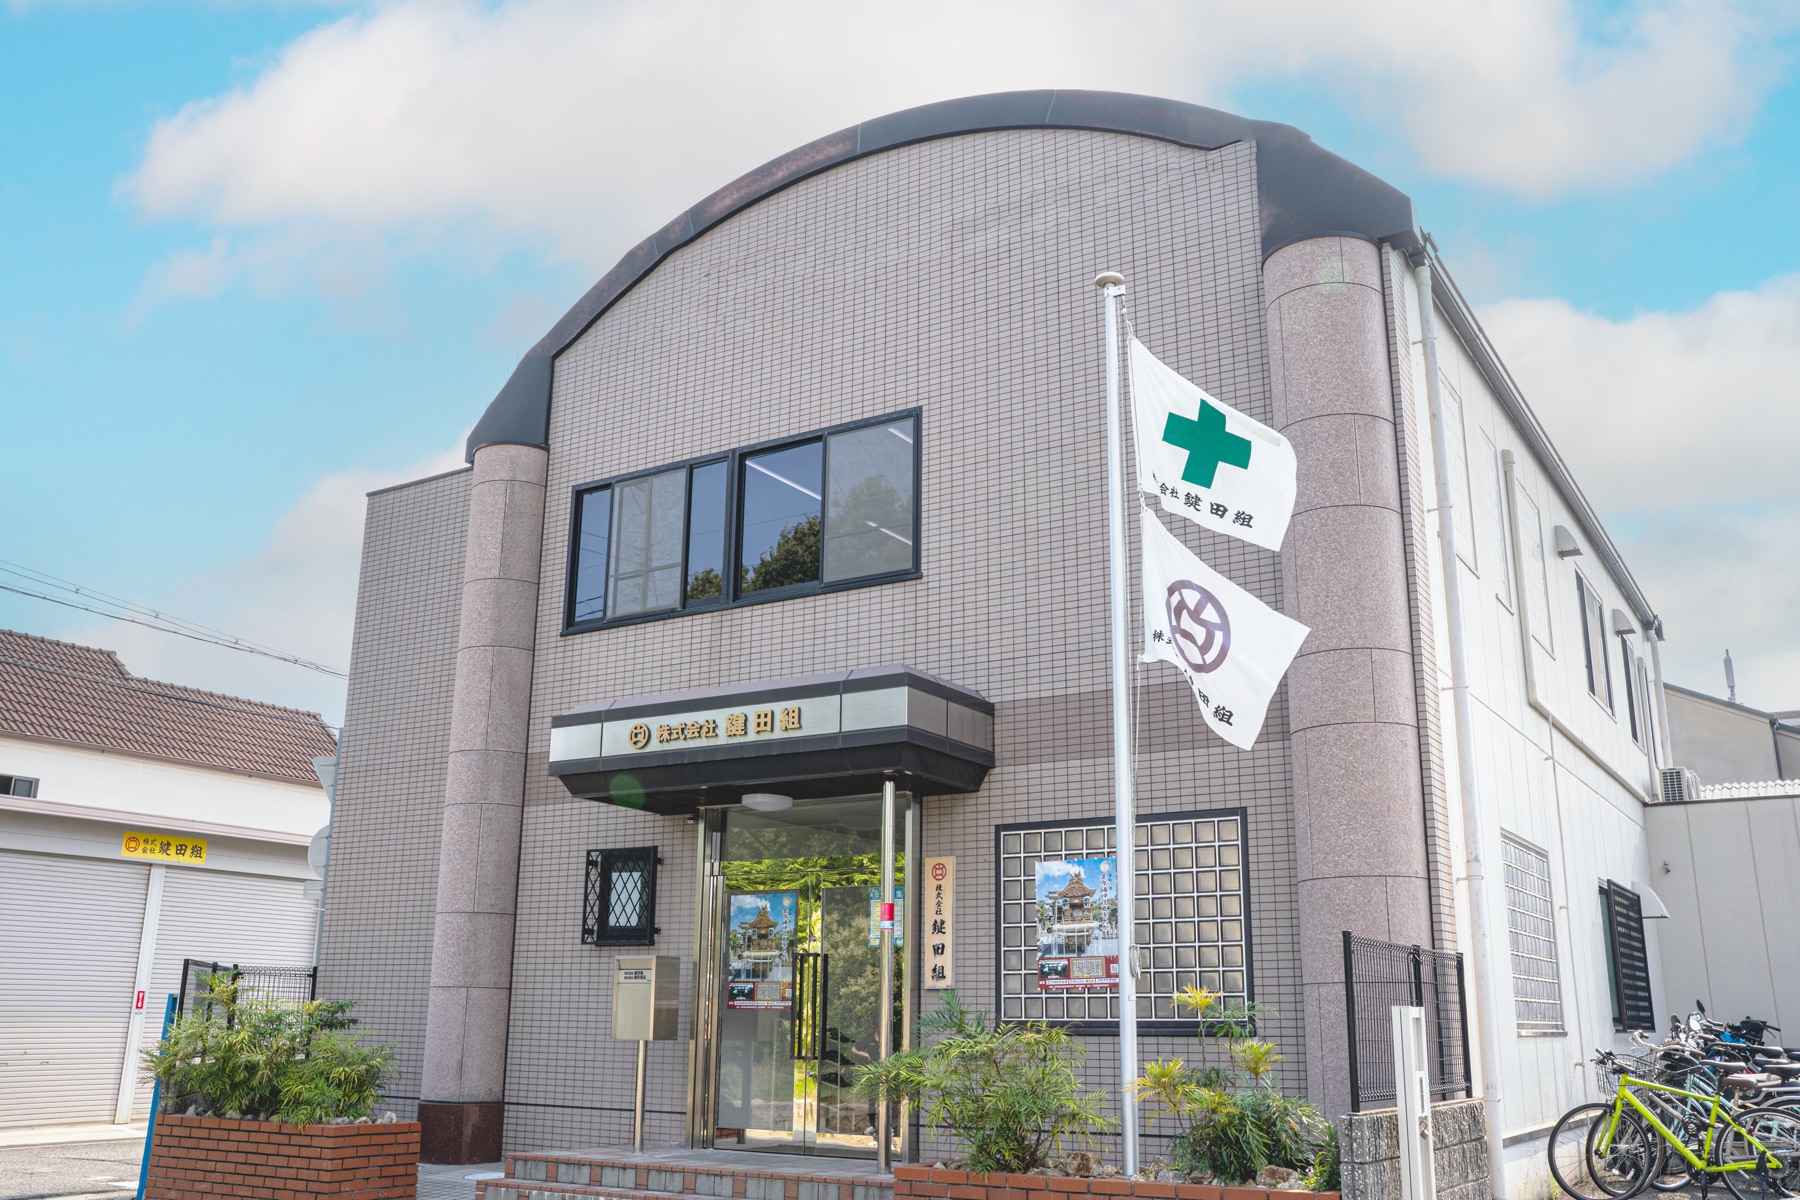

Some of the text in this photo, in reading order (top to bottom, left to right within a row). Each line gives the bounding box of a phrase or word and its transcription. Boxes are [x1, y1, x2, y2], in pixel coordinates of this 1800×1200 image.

[1184, 491, 1254, 529] 鍵田組
[656, 706, 802, 743] 株式会社 鍵田組
[158, 840, 203, 859] 鍵田組
[931, 883, 947, 981] 株式会社 鍵田組
